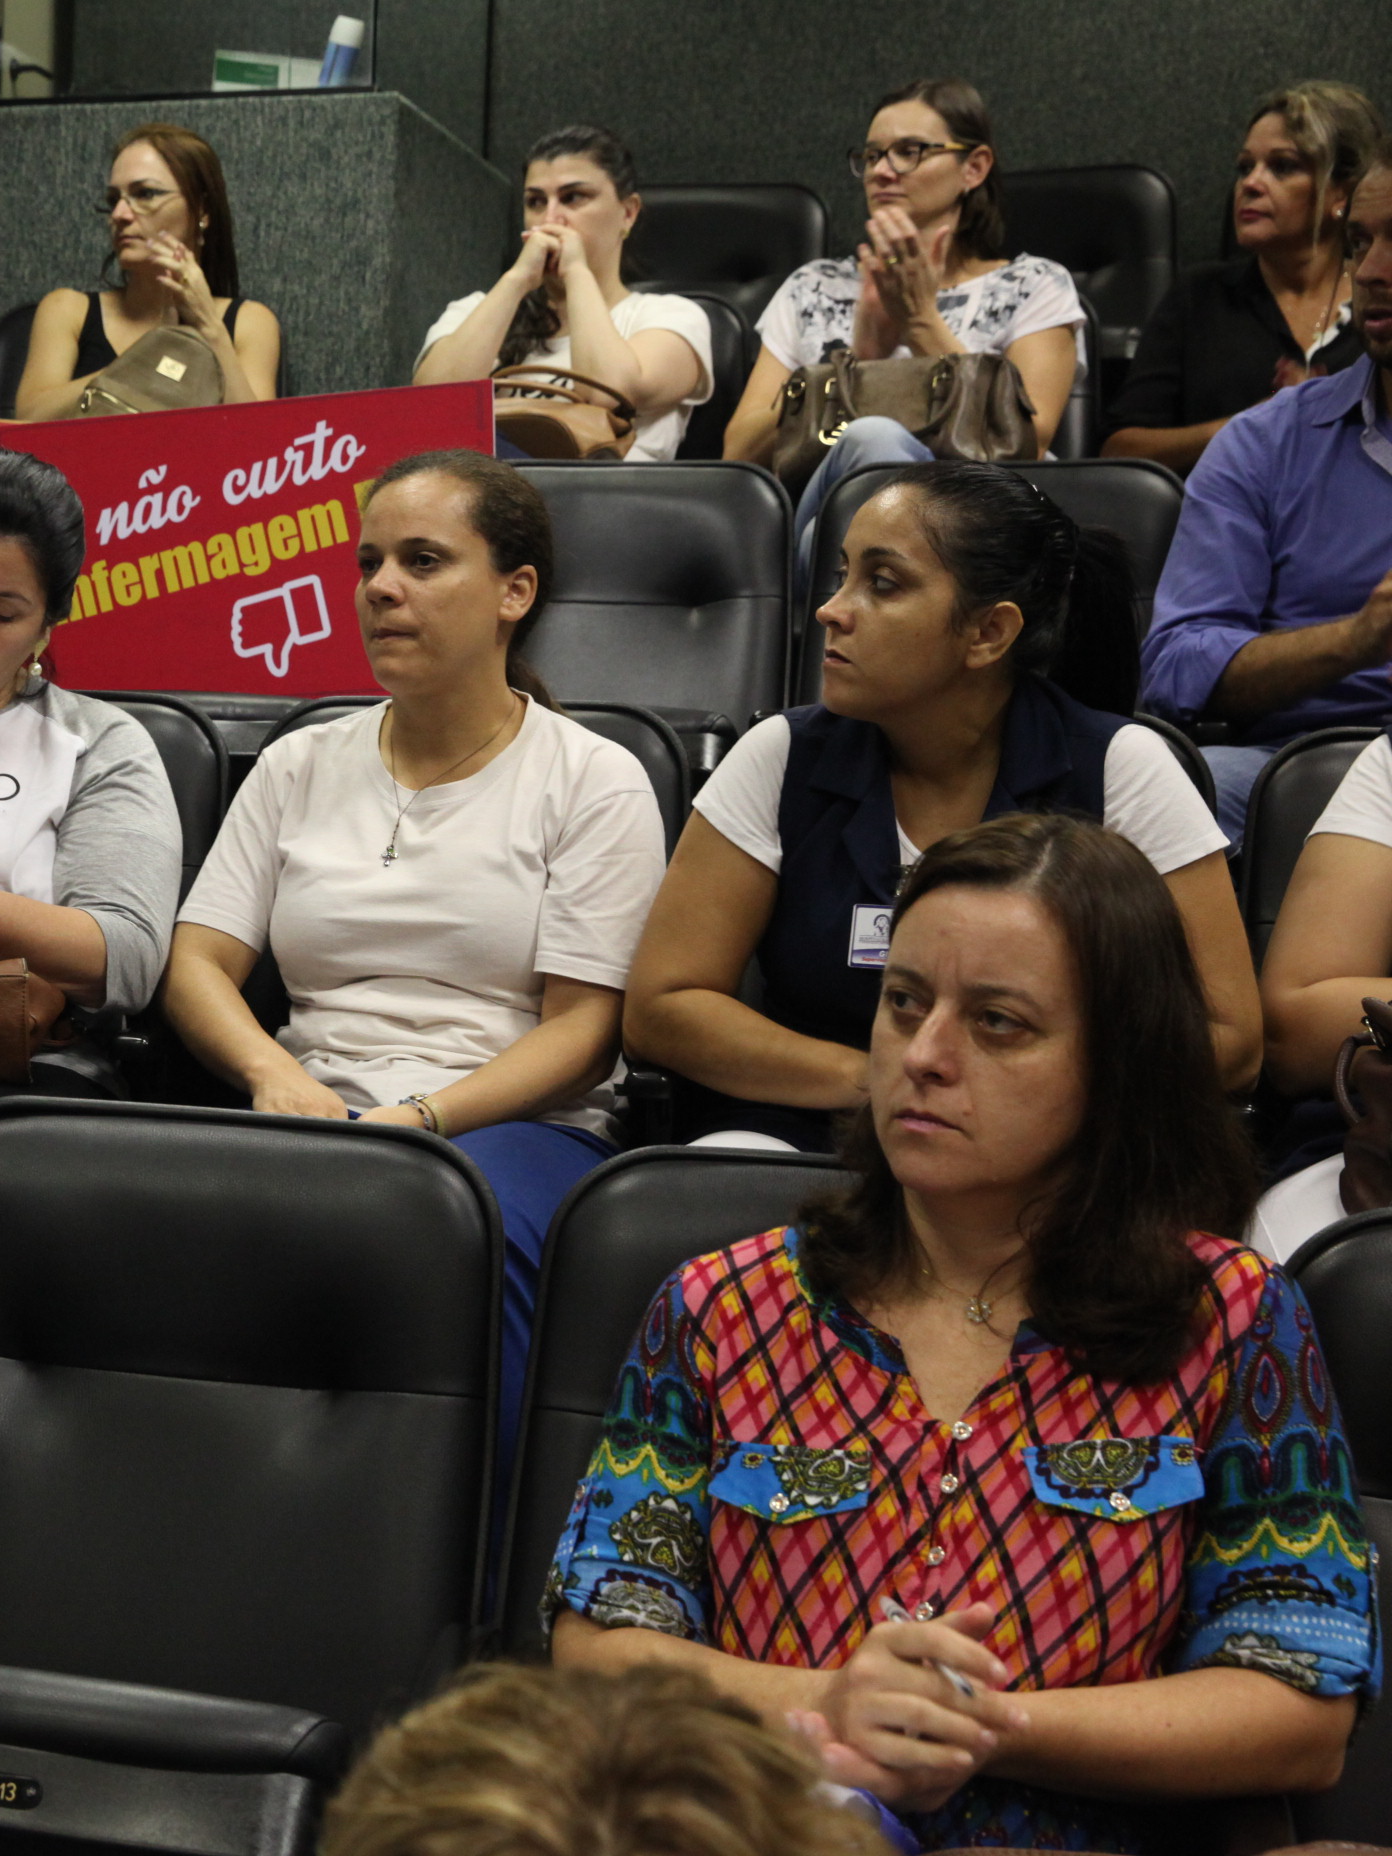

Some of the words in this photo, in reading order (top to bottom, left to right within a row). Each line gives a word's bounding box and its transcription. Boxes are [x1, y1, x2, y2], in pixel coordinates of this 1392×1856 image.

[96, 464, 201, 546] não
[222, 420, 366, 506] curto
[57, 498, 350, 625] nfermagem
[0, 1782, 17, 1801] 13
